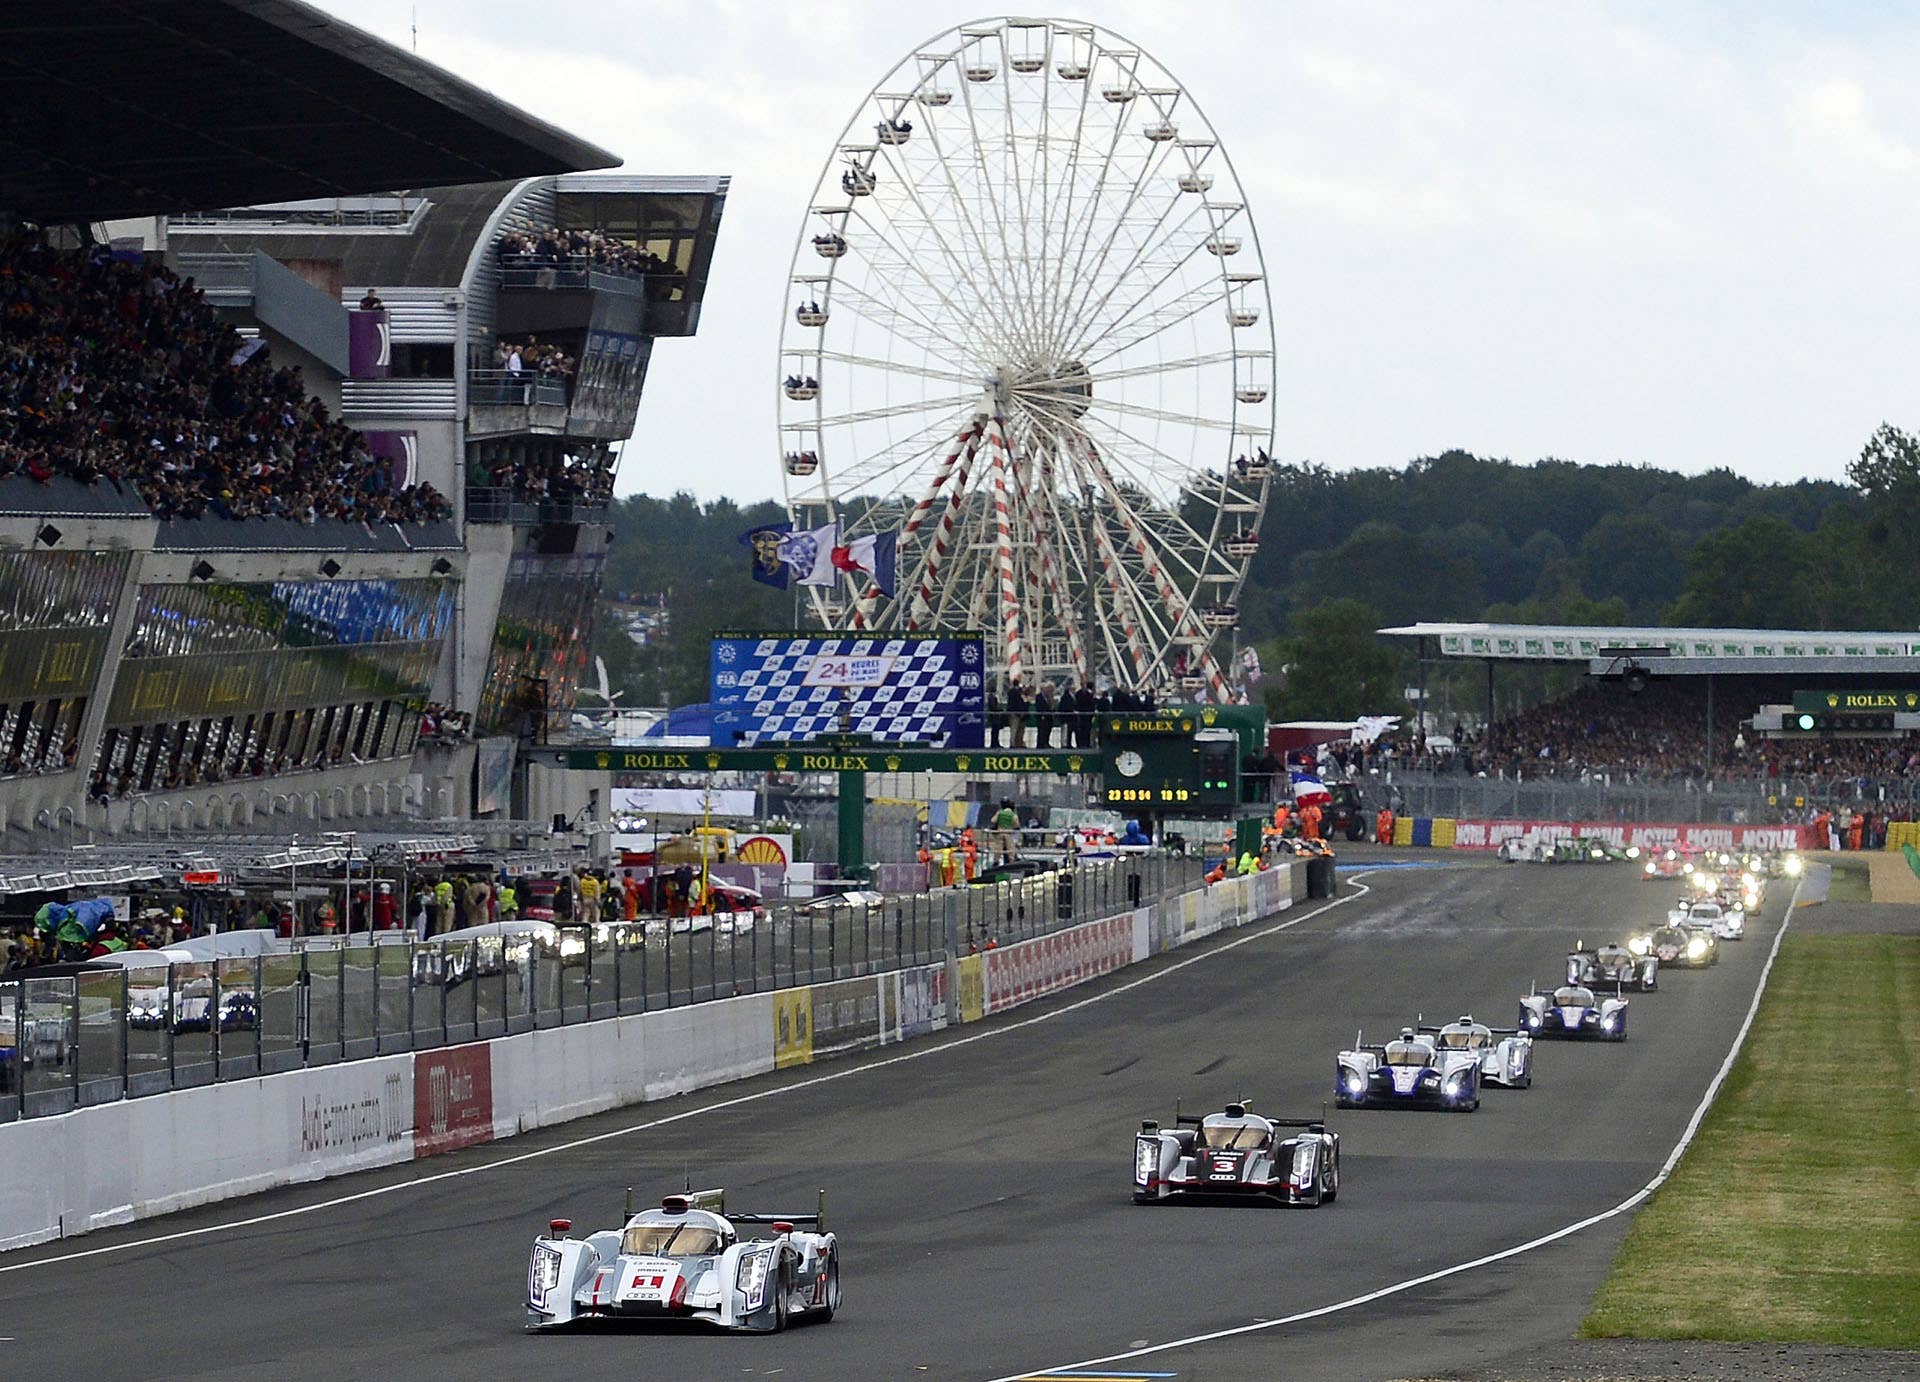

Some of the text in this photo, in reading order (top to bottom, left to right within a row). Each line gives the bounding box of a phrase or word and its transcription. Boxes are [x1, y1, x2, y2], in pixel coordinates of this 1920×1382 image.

[819, 663, 848, 680] 24
[716, 674, 736, 686] FIA
[960, 675, 978, 687] FIA
[1846, 695, 1898, 706] ROLEX
[1128, 720, 1174, 731] ROLEX
[624, 754, 689, 768] ROLEX
[803, 755, 868, 770] ROLEX
[984, 757, 1051, 771] ROLEX
[1742, 829, 1797, 850] MOTUL
[1214, 1161, 1235, 1172] 3
[636, 1276, 656, 1289] 1
